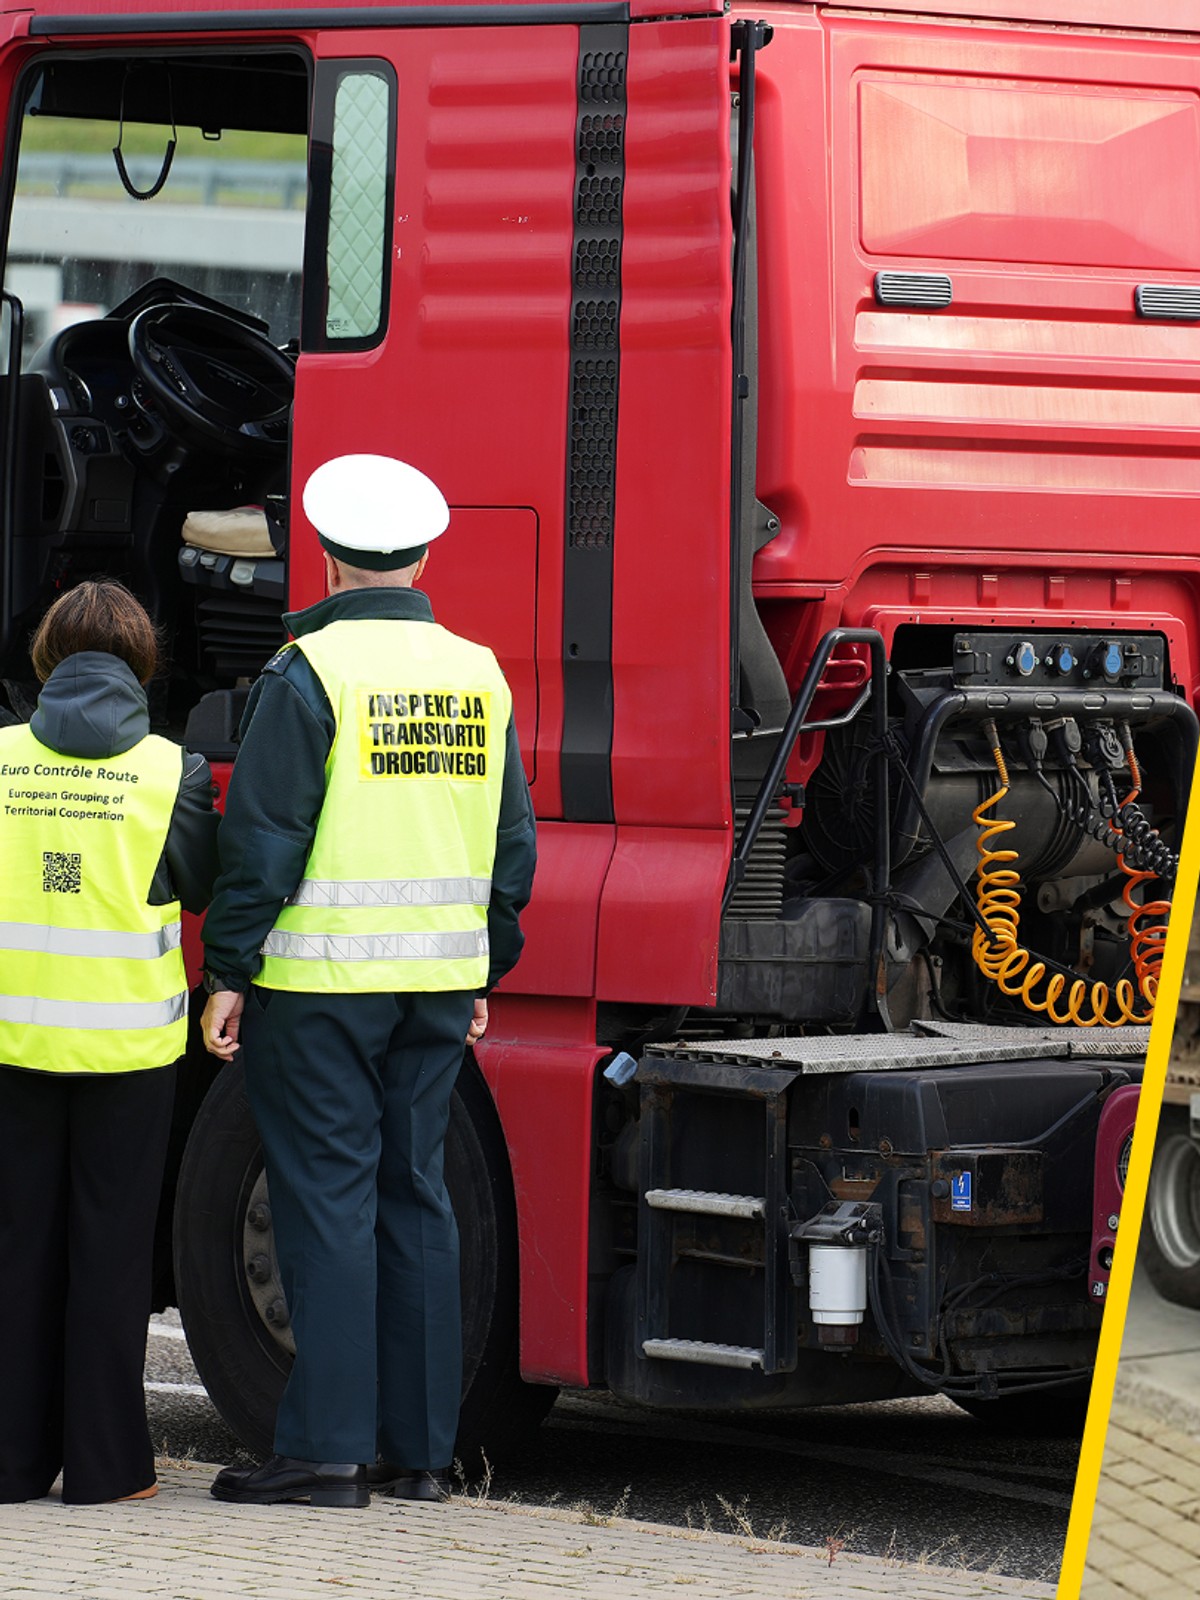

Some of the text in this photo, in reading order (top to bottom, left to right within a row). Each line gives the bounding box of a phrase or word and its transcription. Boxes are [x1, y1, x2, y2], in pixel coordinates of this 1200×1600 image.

[368, 694, 485, 719] INSPEKCJA
[369, 722, 486, 748] TRANSPORTU
[1, 763, 139, 783] Euro Contrôle Route
[371, 750, 486, 776] DROGOWEGO
[8, 788, 125, 805] European Grouping of
[4, 805, 125, 821] Territorial Cooperation
